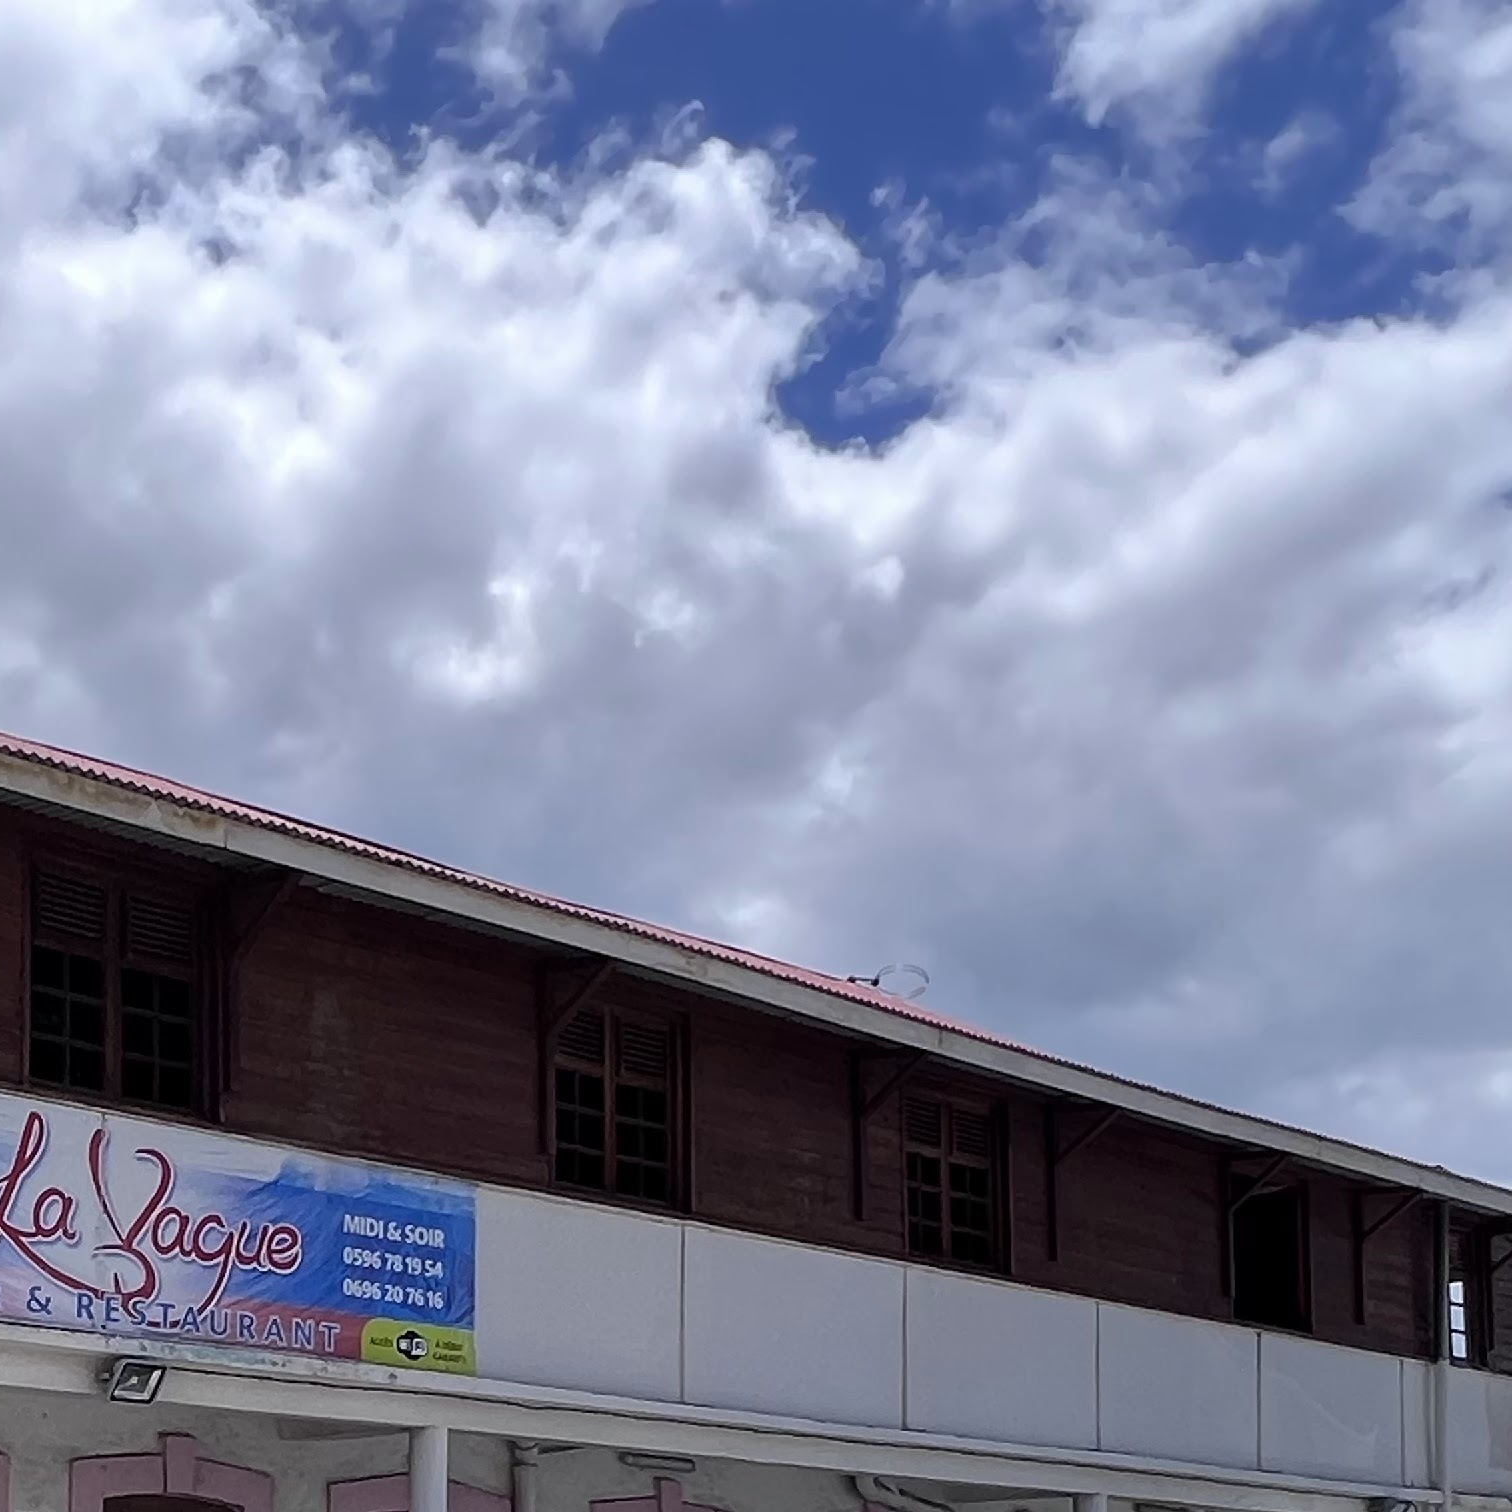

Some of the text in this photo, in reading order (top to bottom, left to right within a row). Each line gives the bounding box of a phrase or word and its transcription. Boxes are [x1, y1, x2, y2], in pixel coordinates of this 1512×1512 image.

[89, 1128, 301, 1330] Vague
[343, 1214, 445, 1249] MIDI & SOIR
[342, 1246, 444, 1280] 0596 78 19 54
[342, 1278, 444, 1310] 0696 20 76 16
[28, 1286, 52, 1316] &
[76, 1292, 341, 1353] RESTAURANT
